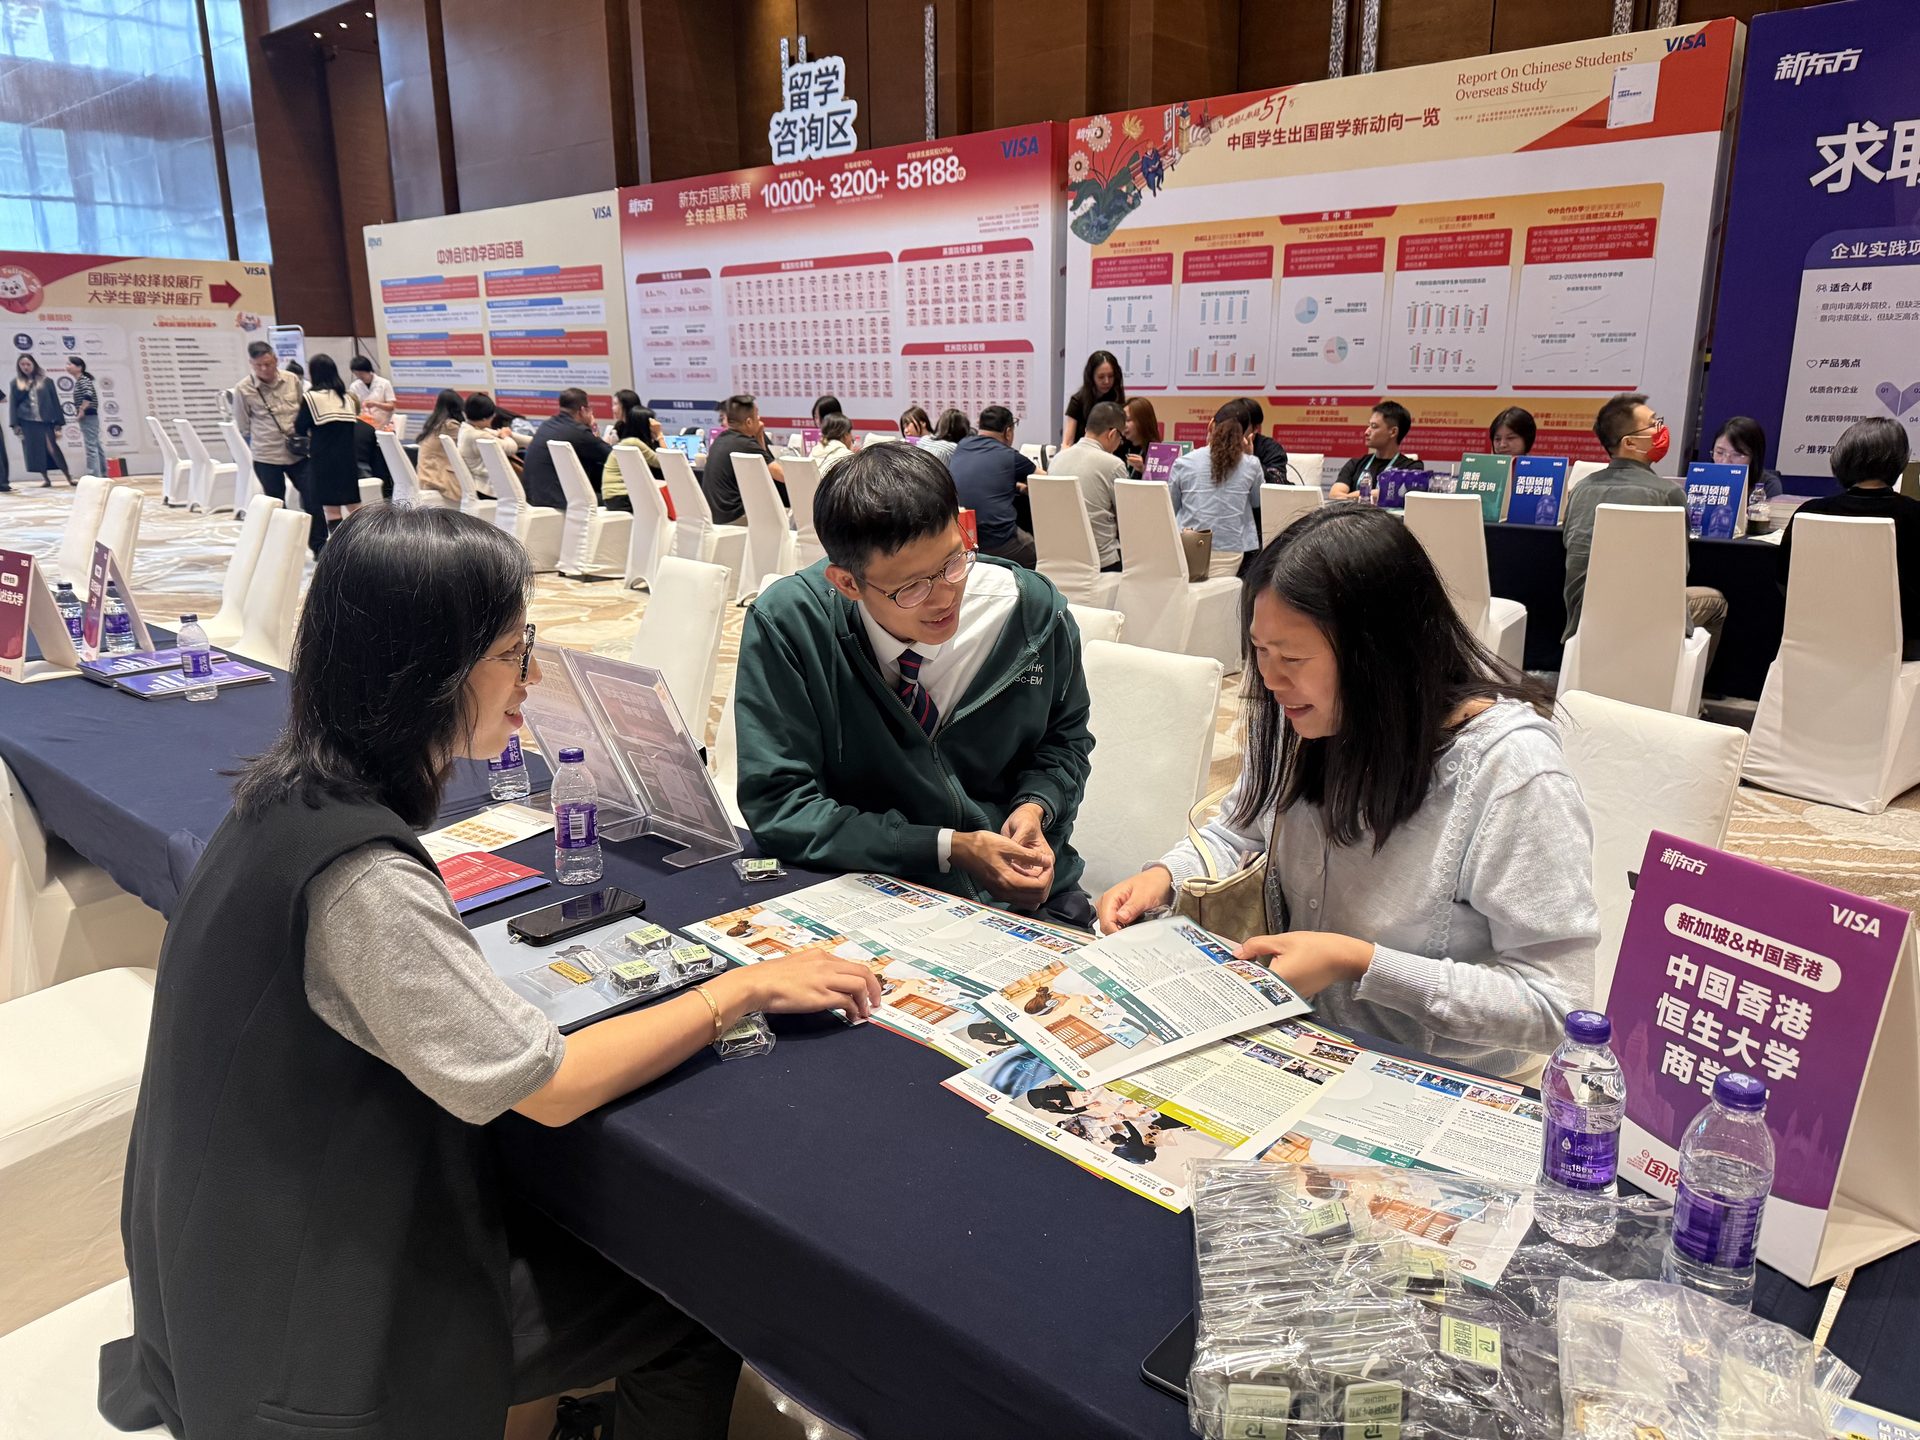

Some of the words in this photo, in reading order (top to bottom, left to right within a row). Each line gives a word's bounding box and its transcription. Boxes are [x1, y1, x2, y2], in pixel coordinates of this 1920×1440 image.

[1664, 33, 1706, 52] VISA
[1457, 71, 1497, 86] Report
[1500, 67, 1519, 80] On
[1522, 61, 1572, 78] Chinese
[1775, 49, 1863, 86] 新东方
[789, 66, 841, 112] 留学
[1456, 84, 1508, 101] Overseas
[1511, 79, 1547, 93] Study
[774, 109, 852, 157] 咨询区
[1227, 107, 1440, 151] 中国学生出国留学新动向一览
[1001, 137, 1039, 159] VISA
[830, 168, 889, 199] 3200+
[897, 156, 959, 190] 58188
[679, 182, 752, 208] 新东方国际教育
[761, 177, 825, 208] 10000+
[593, 205, 612, 219] VISA
[685, 203, 748, 226] 全年成果展示
[437, 240, 524, 265] 中外合作办学百问百答
[88, 272, 203, 289] 国际学校择校展厅
[244, 266, 266, 276] VISA
[88, 290, 203, 305] 大学生留学讲座厅
[1830, 282, 1873, 293] 适合人群
[1819, 359, 1861, 368] 产品亮点
[1809, 386, 1859, 394] 优质合作企业
[1461, 481, 1496, 492] 留学咨询
[1462, 471, 1480, 481] 澳新
[1516, 476, 1553, 488] 英国硕博
[1515, 484, 1552, 496] 留学咨询
[1688, 484, 1730, 497] 英国硕博
[1660, 848, 1708, 875] 新东方
[1830, 904, 1880, 938] VISA
[1677, 912, 1823, 982] 新加坡&中国香港
[1665, 953, 1812, 1040] 中国香港
[1656, 993, 1801, 1081] 恒生大学
